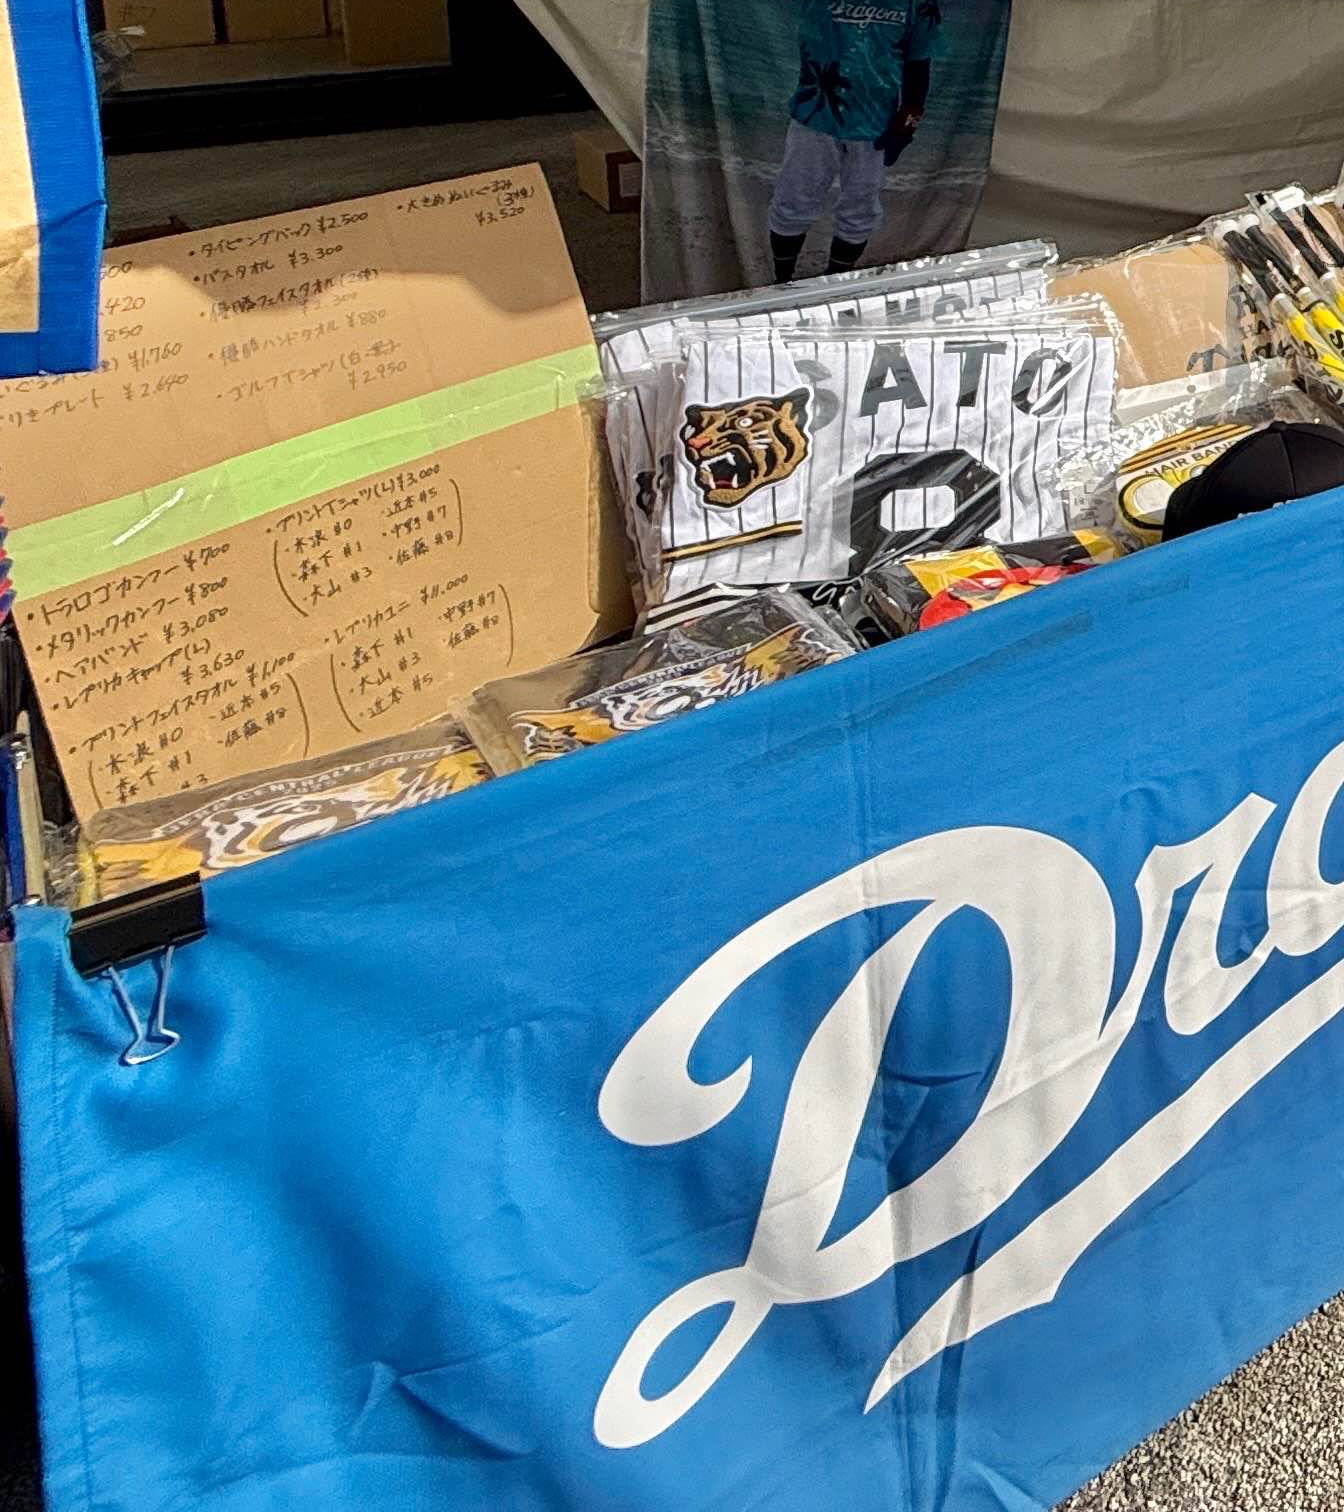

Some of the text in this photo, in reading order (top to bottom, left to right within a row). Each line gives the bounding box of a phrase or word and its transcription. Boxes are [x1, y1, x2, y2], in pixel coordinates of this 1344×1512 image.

[202, 260, 275, 285] バスタオル
[1145, 457, 1187, 477] HAIR
[54, 632, 149, 684] ヘアバンド
